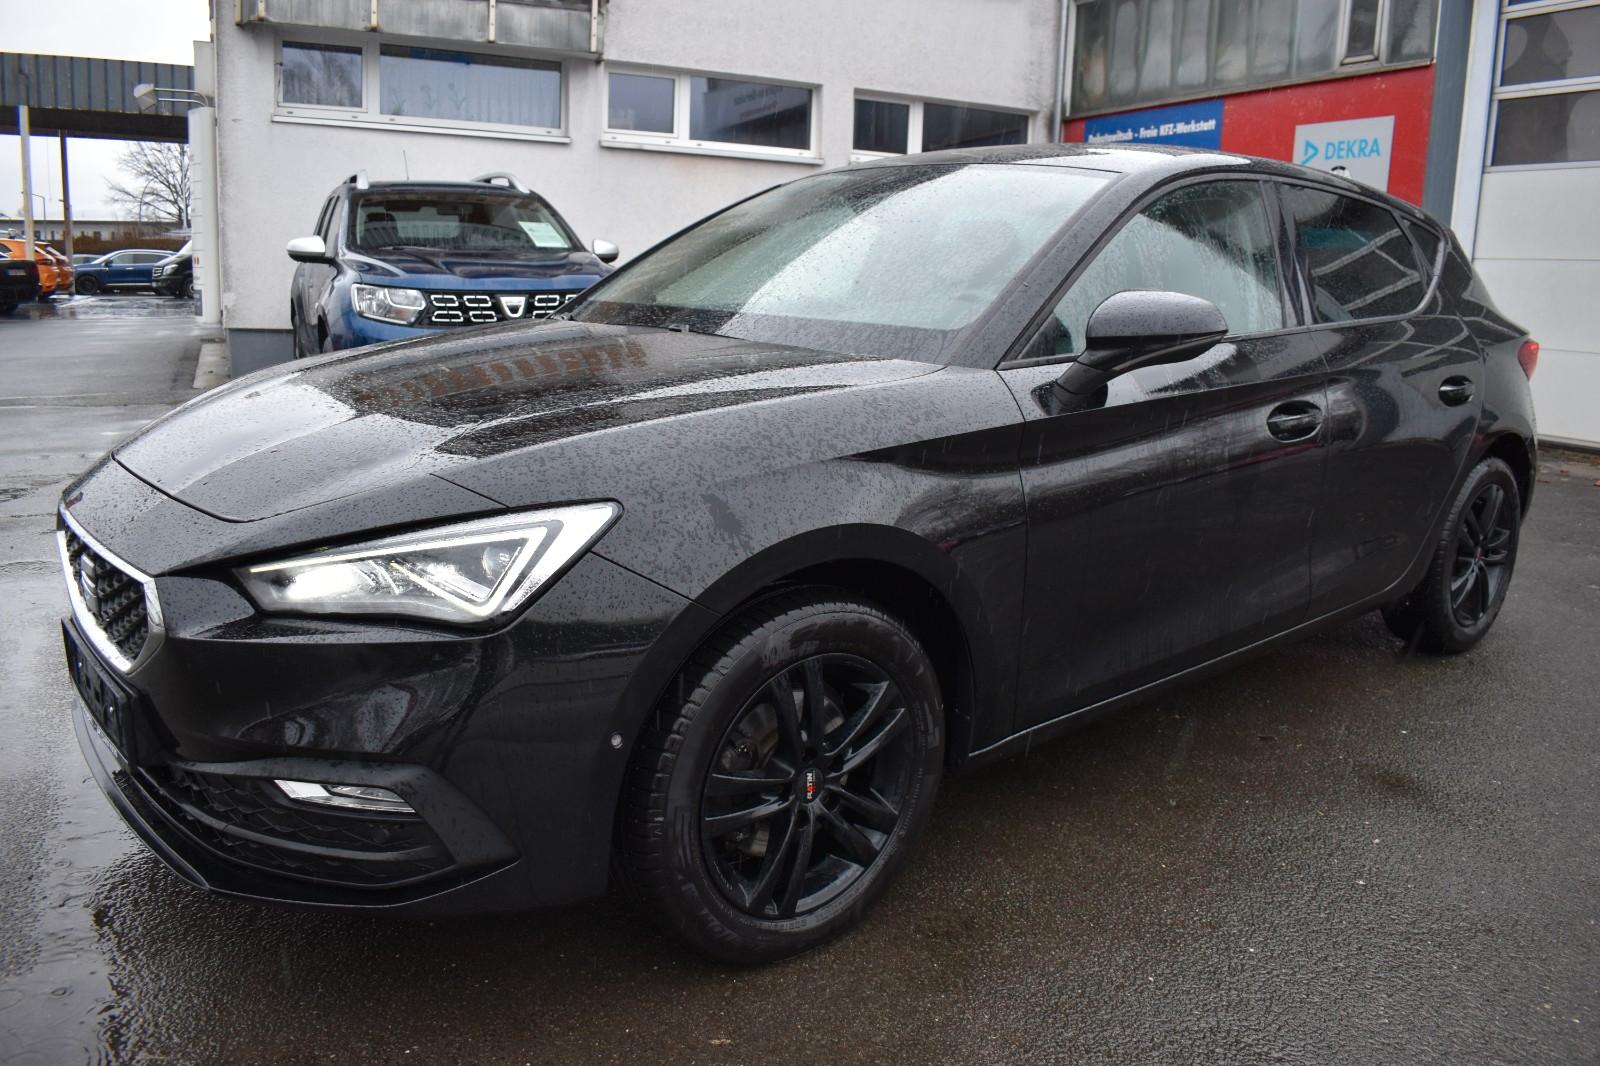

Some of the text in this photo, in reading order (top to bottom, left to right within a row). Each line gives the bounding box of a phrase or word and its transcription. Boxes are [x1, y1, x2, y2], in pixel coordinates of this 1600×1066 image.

[1139, 125, 1158, 139] Freie
[1159, 119, 1216, 136] KFZ-Werkstatt
[1325, 137, 1380, 160] DEKRA
